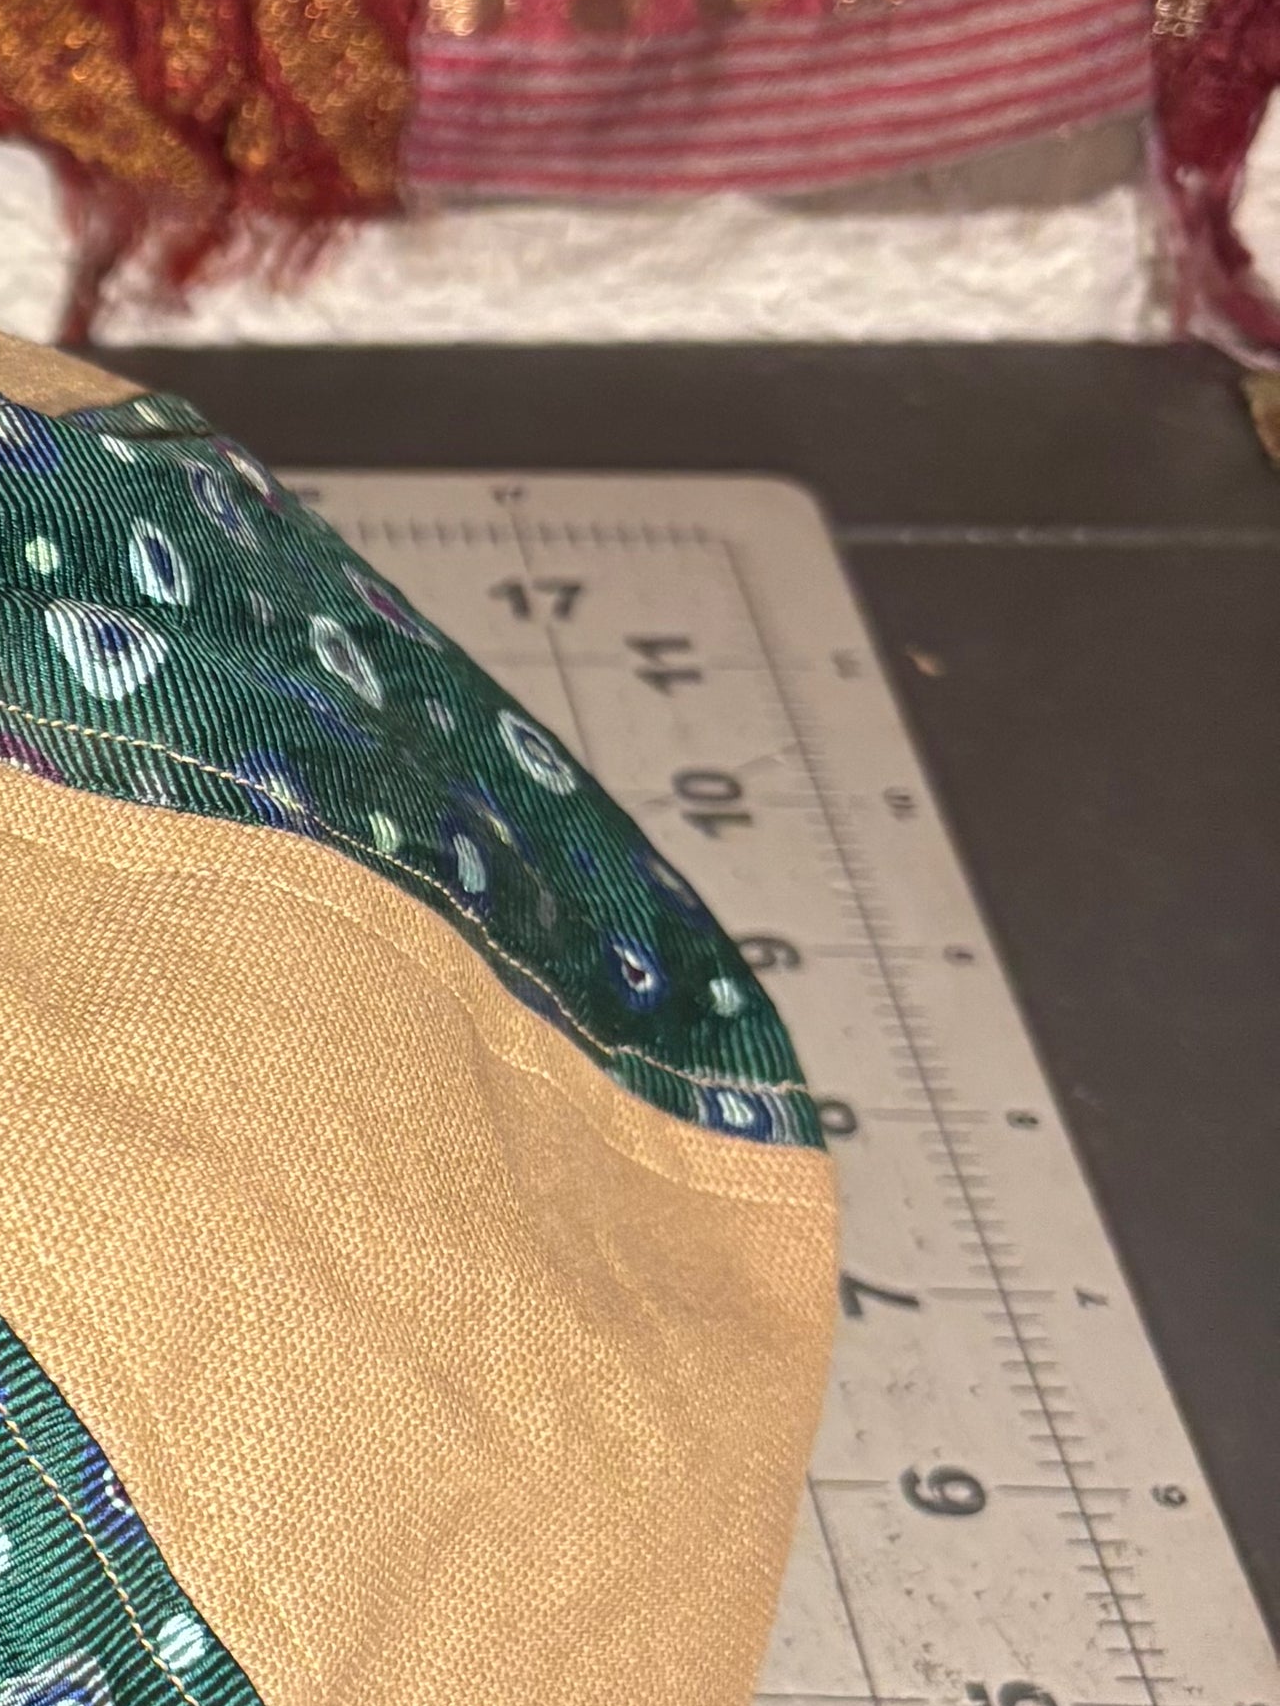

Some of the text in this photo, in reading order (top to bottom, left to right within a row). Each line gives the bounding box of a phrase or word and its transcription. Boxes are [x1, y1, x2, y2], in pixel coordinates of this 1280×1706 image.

[487, 577, 584, 621] 17
[624, 635, 702, 695] 11
[672, 767, 754, 838] 10
[740, 936, 801, 971] 9
[842, 1271, 922, 1318] 7
[1073, 1286, 1109, 1308] 7
[899, 1463, 987, 1516] 6
[1151, 1483, 1188, 1508] 6
